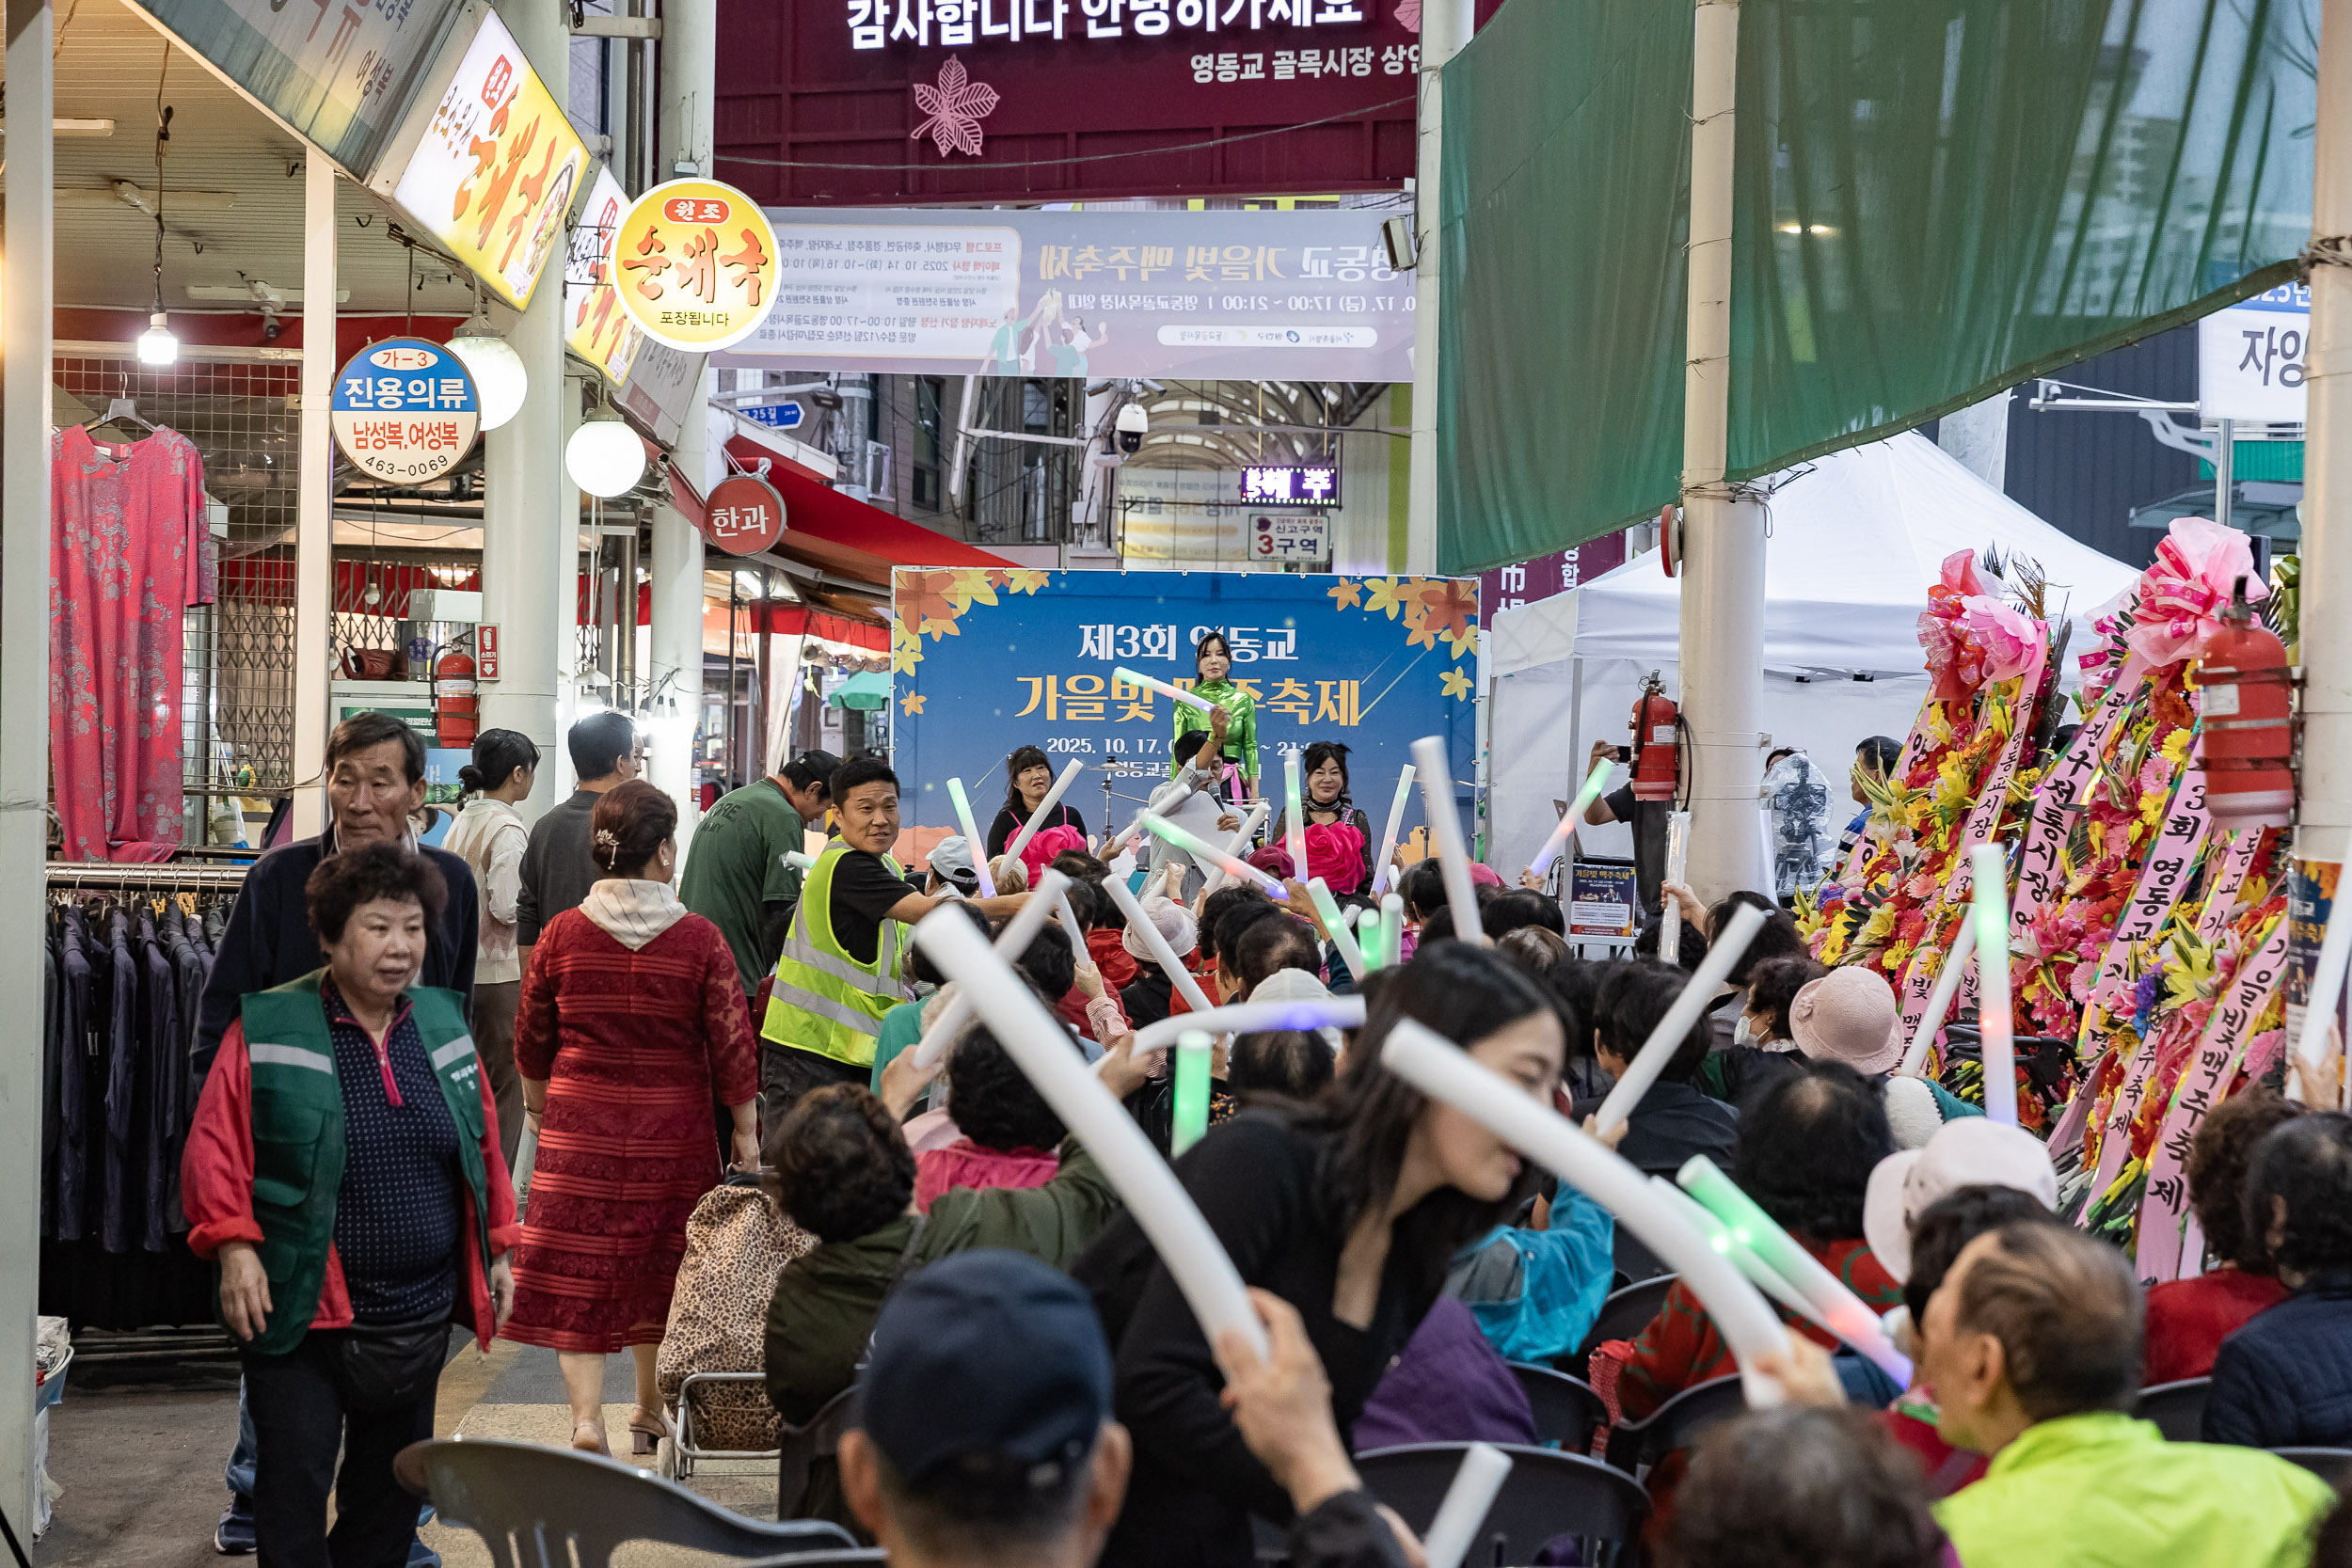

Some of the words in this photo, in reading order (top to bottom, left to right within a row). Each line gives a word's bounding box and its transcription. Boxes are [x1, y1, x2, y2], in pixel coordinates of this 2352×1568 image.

[847, 0, 1069, 49] 감사합니다
[1190, 53, 1265, 84] 영동교
[1272, 46, 1375, 80] 골목시장
[675, 200, 722, 222] 원조
[660, 311, 729, 326] 포장됩니다
[381, 351, 428, 368] 가-3
[344, 377, 468, 409] 진용의류
[353, 421, 459, 451] 남성복.여성복
[365, 455, 449, 477] 463-0069
[710, 504, 770, 538] 한과
[1276, 524, 1323, 534] 신고구역
[1077, 624, 1177, 661] 제3회
[1015, 673, 1155, 723] 가을빛
[1046, 737, 1096, 754] 2025.
[1104, 738, 1129, 753] 10.
[1134, 739, 1162, 754] 17.
[2164, 784, 2206, 845] 3회
